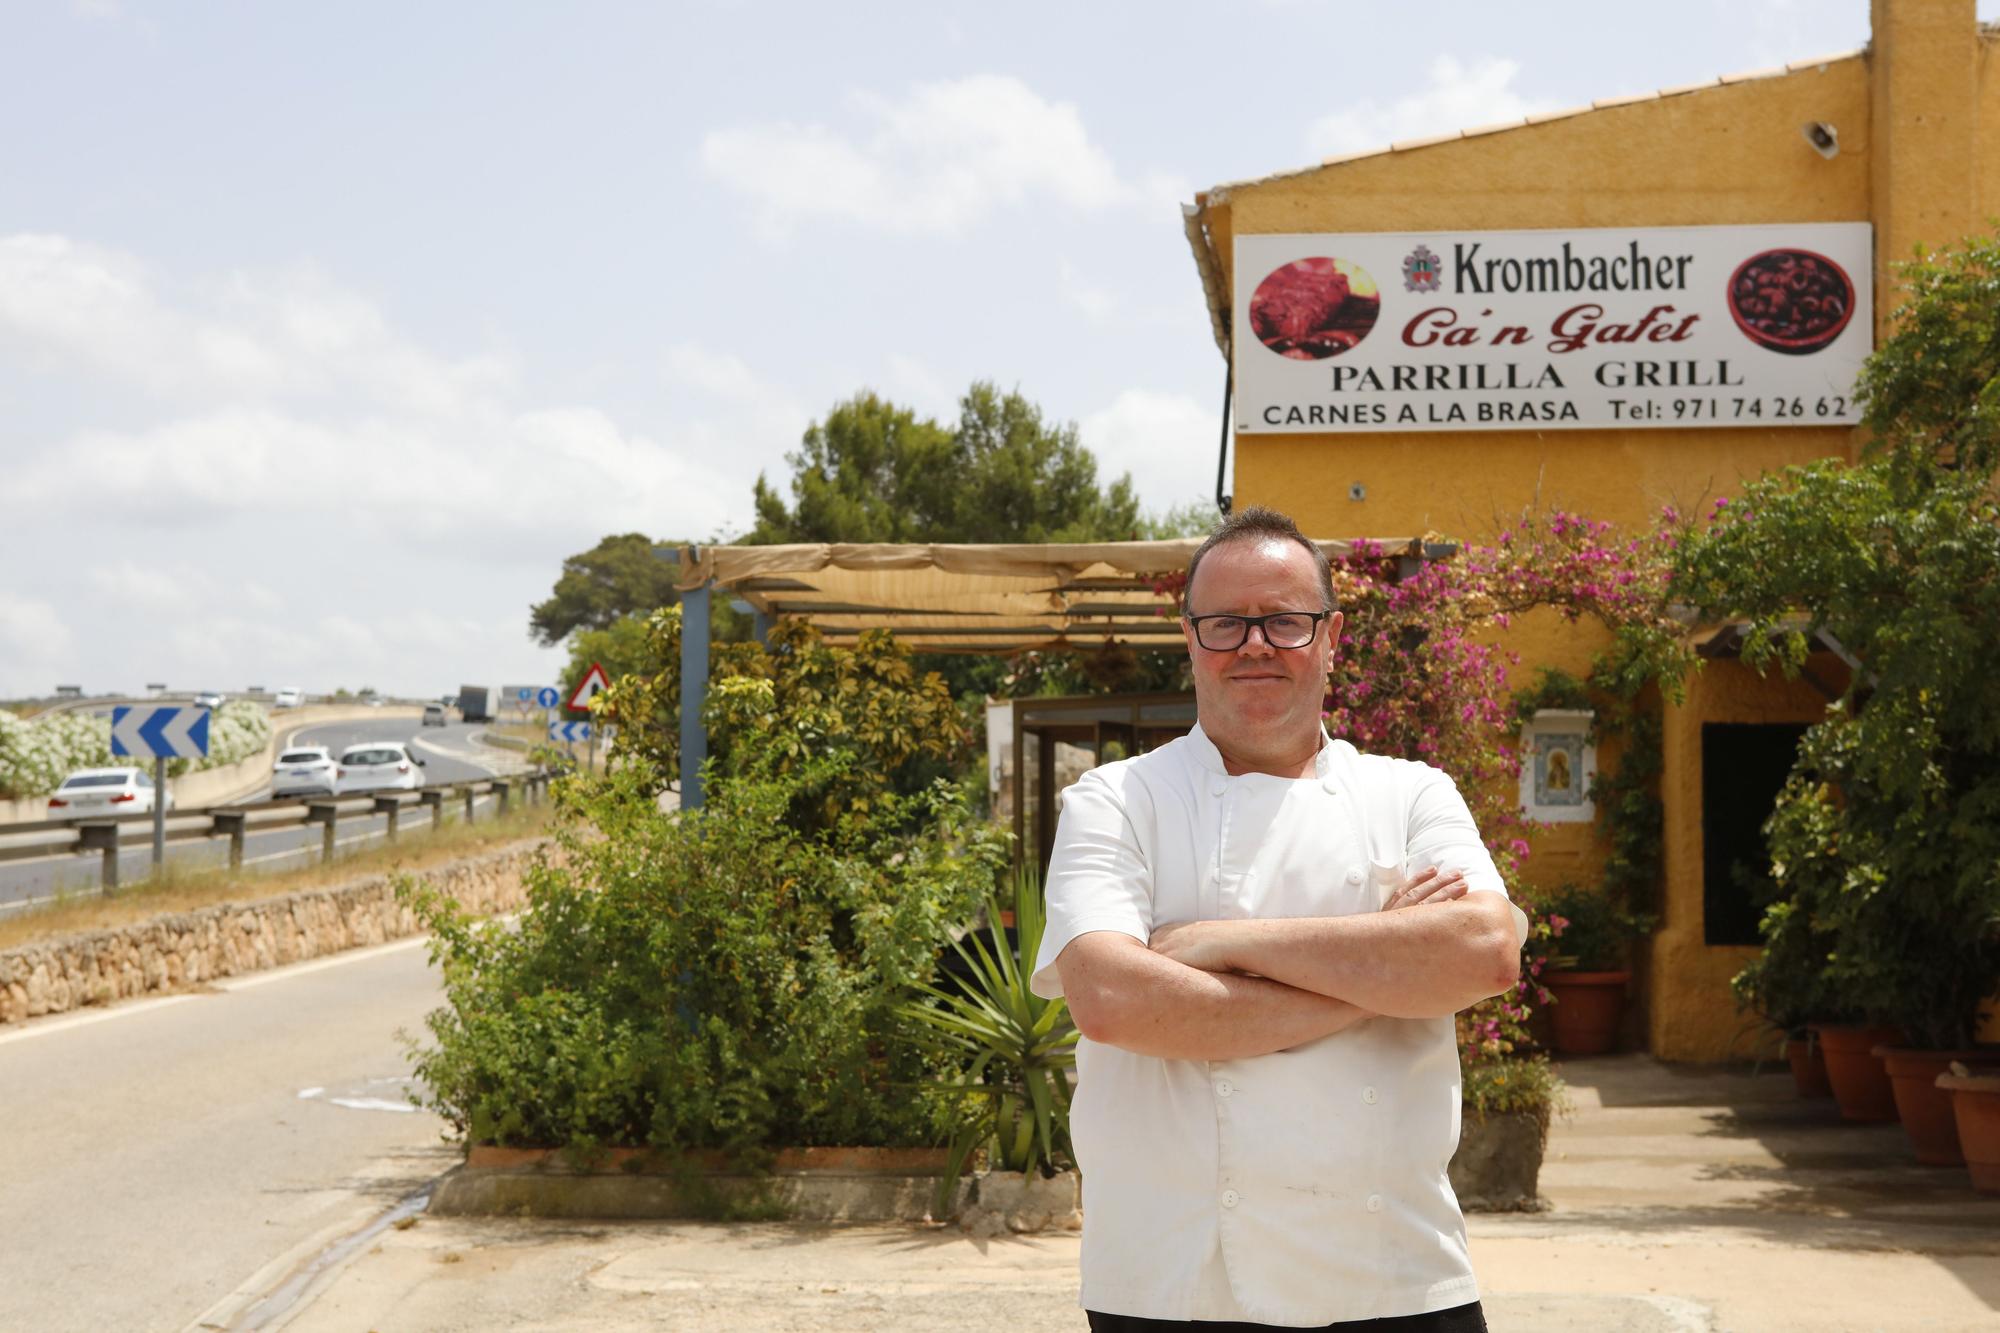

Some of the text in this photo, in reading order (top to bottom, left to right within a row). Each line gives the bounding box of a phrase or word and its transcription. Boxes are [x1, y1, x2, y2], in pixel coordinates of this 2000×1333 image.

[1454, 240, 1693, 294] Krombacher
[1547, 304, 1701, 353] Gafet
[1333, 360, 1745, 392] PARRILLA GRILL
[1263, 396, 1847, 425] CARNES A LA BRASA Tel: 971 74 26 62
